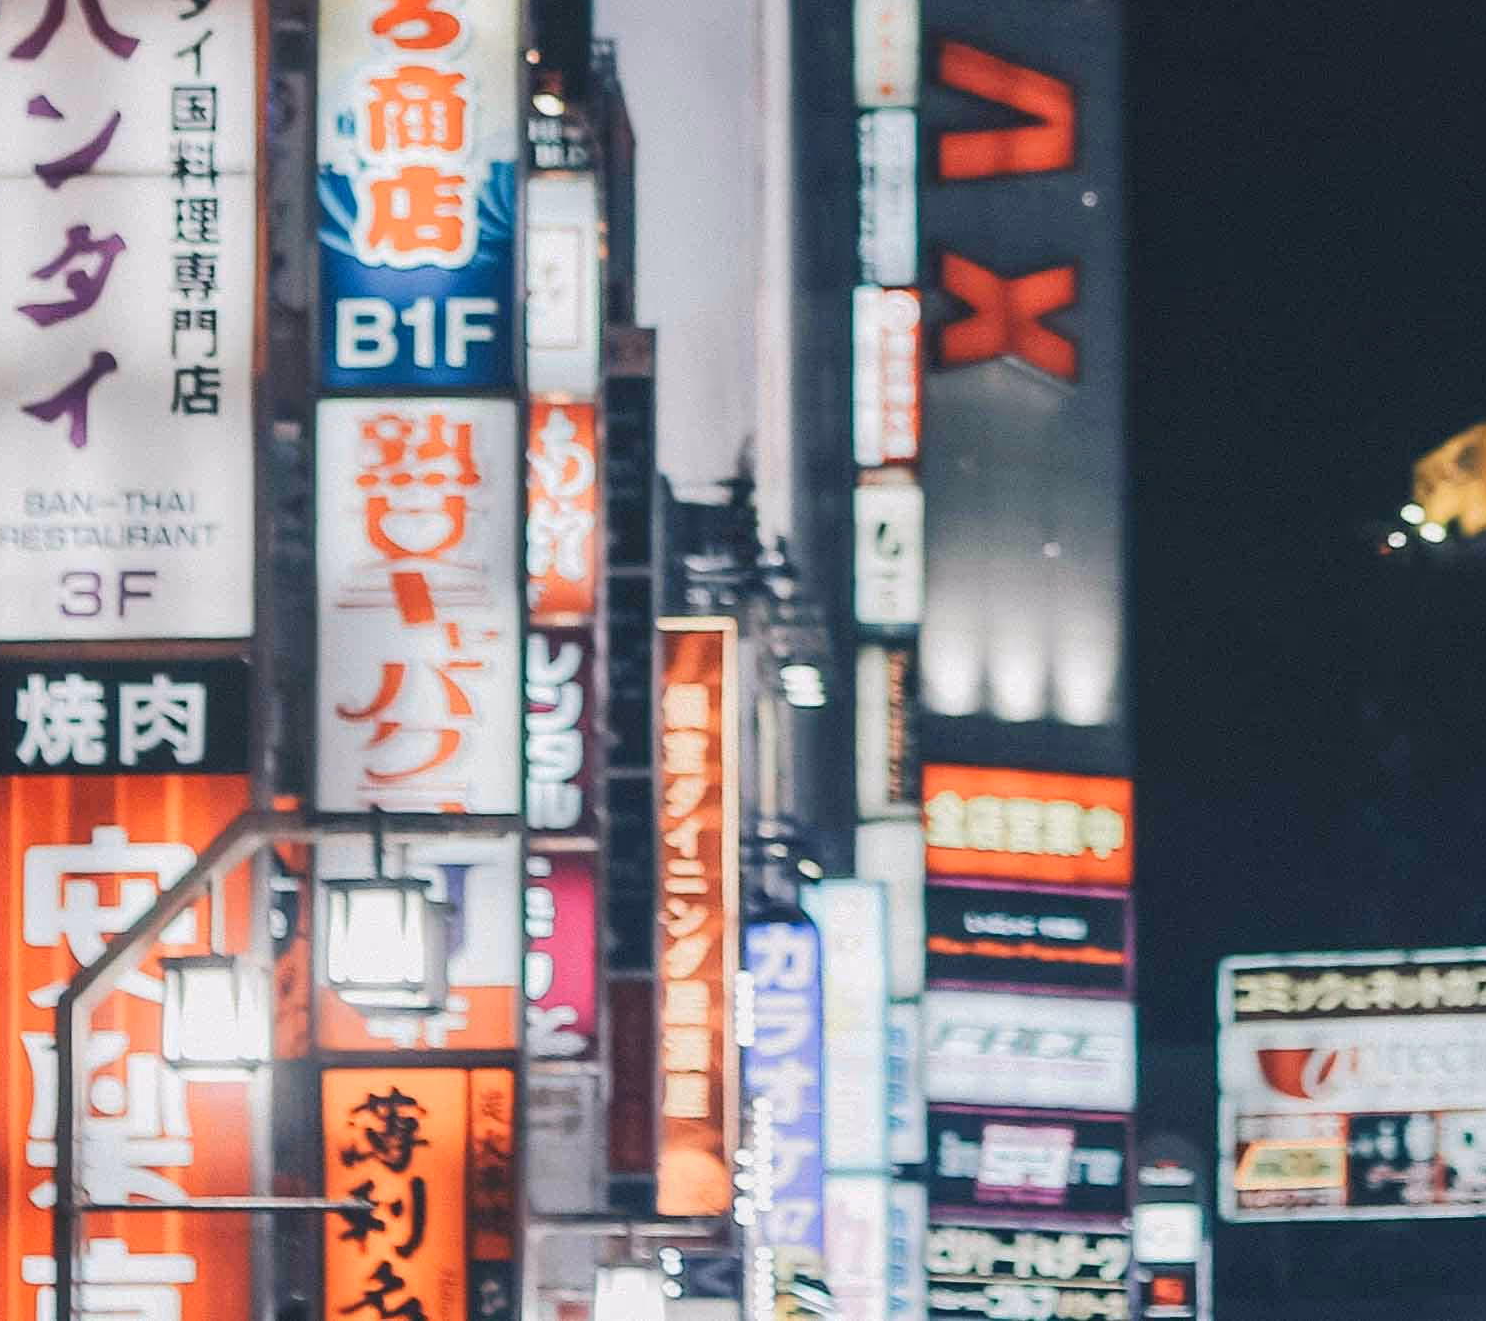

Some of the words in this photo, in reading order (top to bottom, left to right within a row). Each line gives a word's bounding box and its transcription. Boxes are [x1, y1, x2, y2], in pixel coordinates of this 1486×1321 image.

[335, 296, 499, 369] B1F
[24, 490, 196, 518] BAN-THAI
[57, 570, 158, 619] 3F
[14, 672, 209, 767] 焼肉
